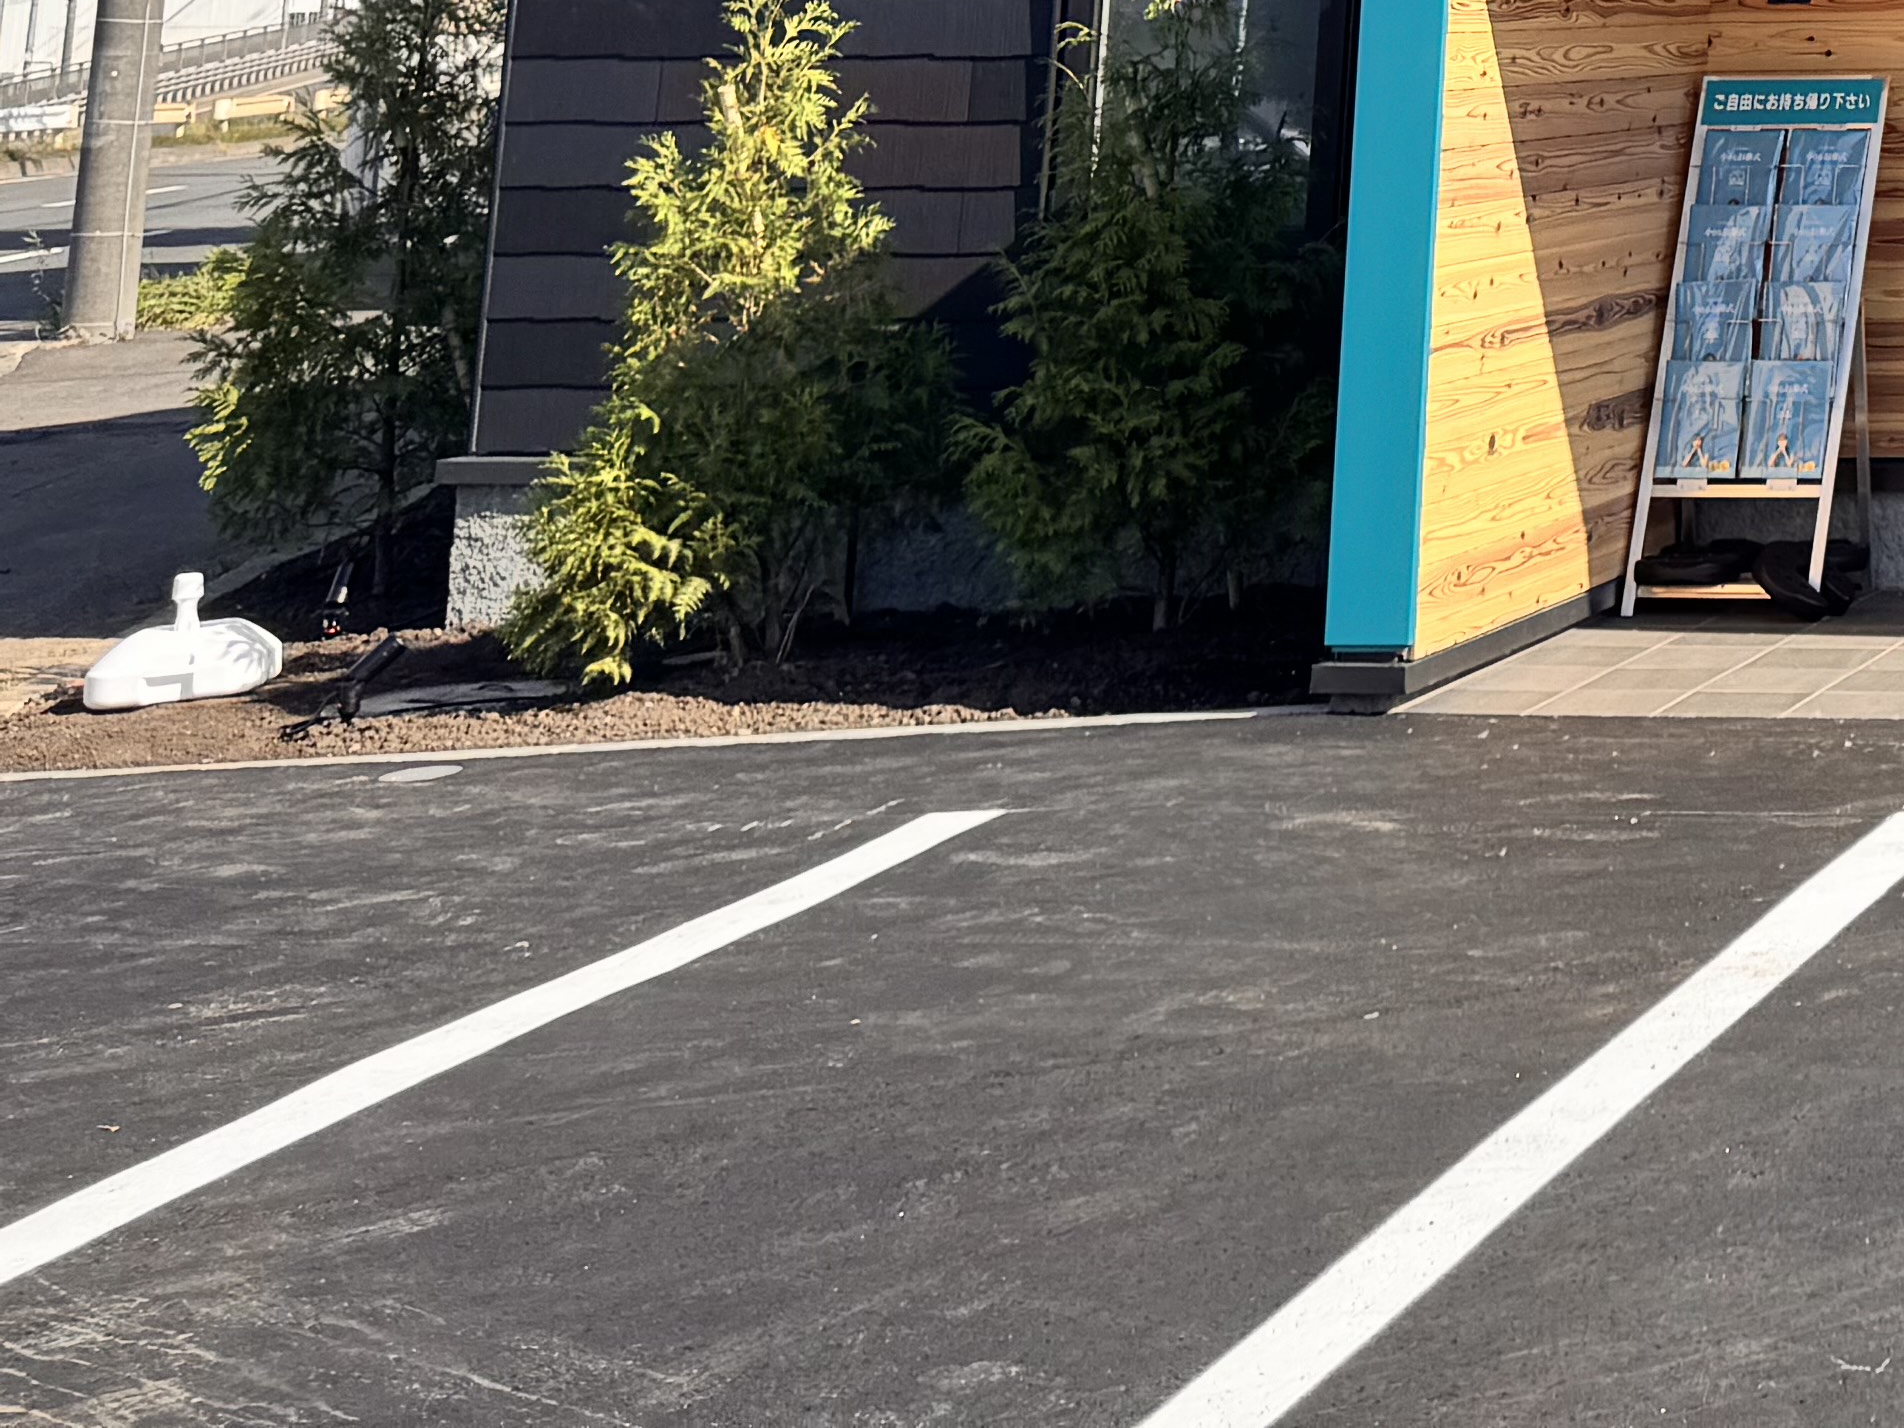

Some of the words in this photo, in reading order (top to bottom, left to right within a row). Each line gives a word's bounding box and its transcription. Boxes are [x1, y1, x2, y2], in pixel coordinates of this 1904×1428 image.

[1714, 93, 1871, 111] ご自由にお持ち帰り下さい
